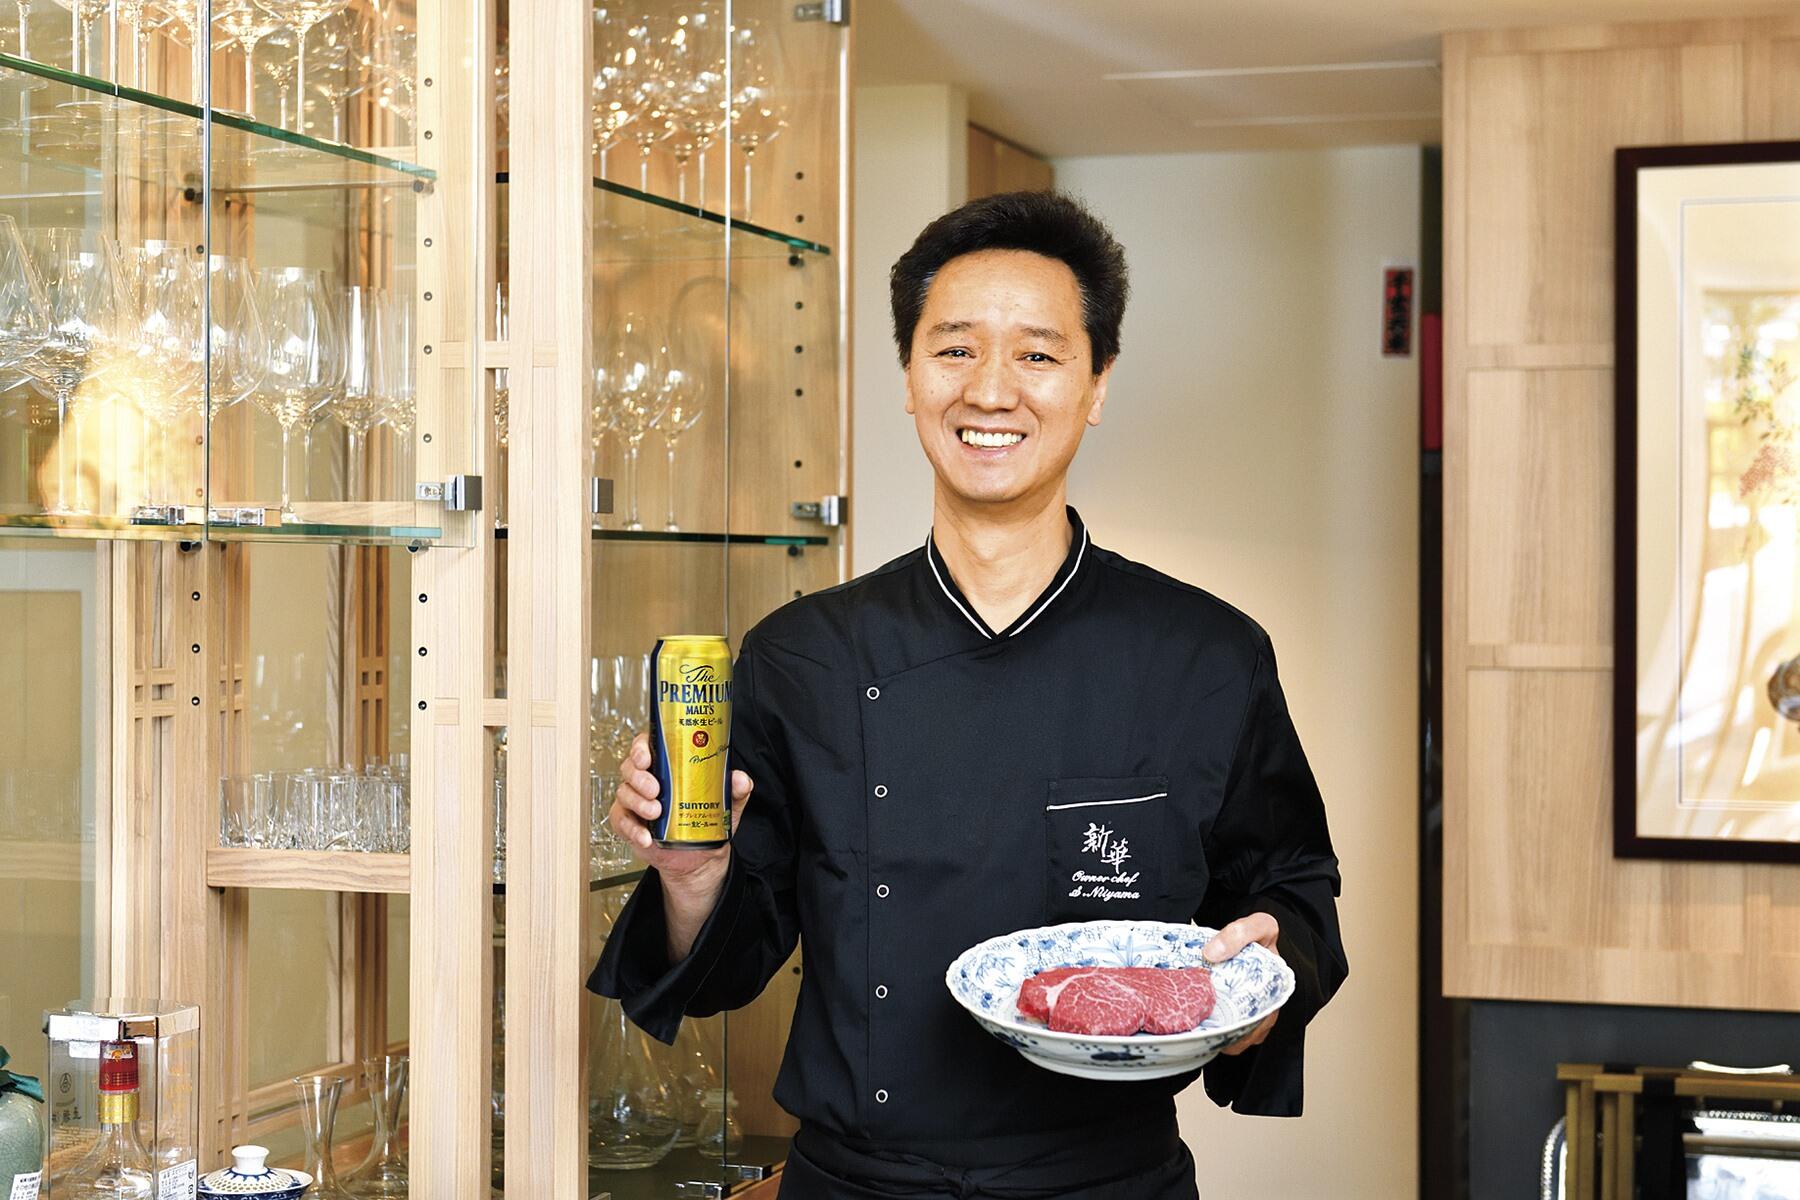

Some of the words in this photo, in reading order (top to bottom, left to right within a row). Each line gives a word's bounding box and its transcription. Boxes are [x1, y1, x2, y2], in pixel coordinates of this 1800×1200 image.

[679, 664, 720, 683] The
[659, 680, 733, 703] PREMIUM
[686, 704, 715, 715] MALT'S
[679, 802, 720, 810] SUNTORY
[1071, 870, 1110, 883] Owner
[1110, 871, 1140, 887] chef
